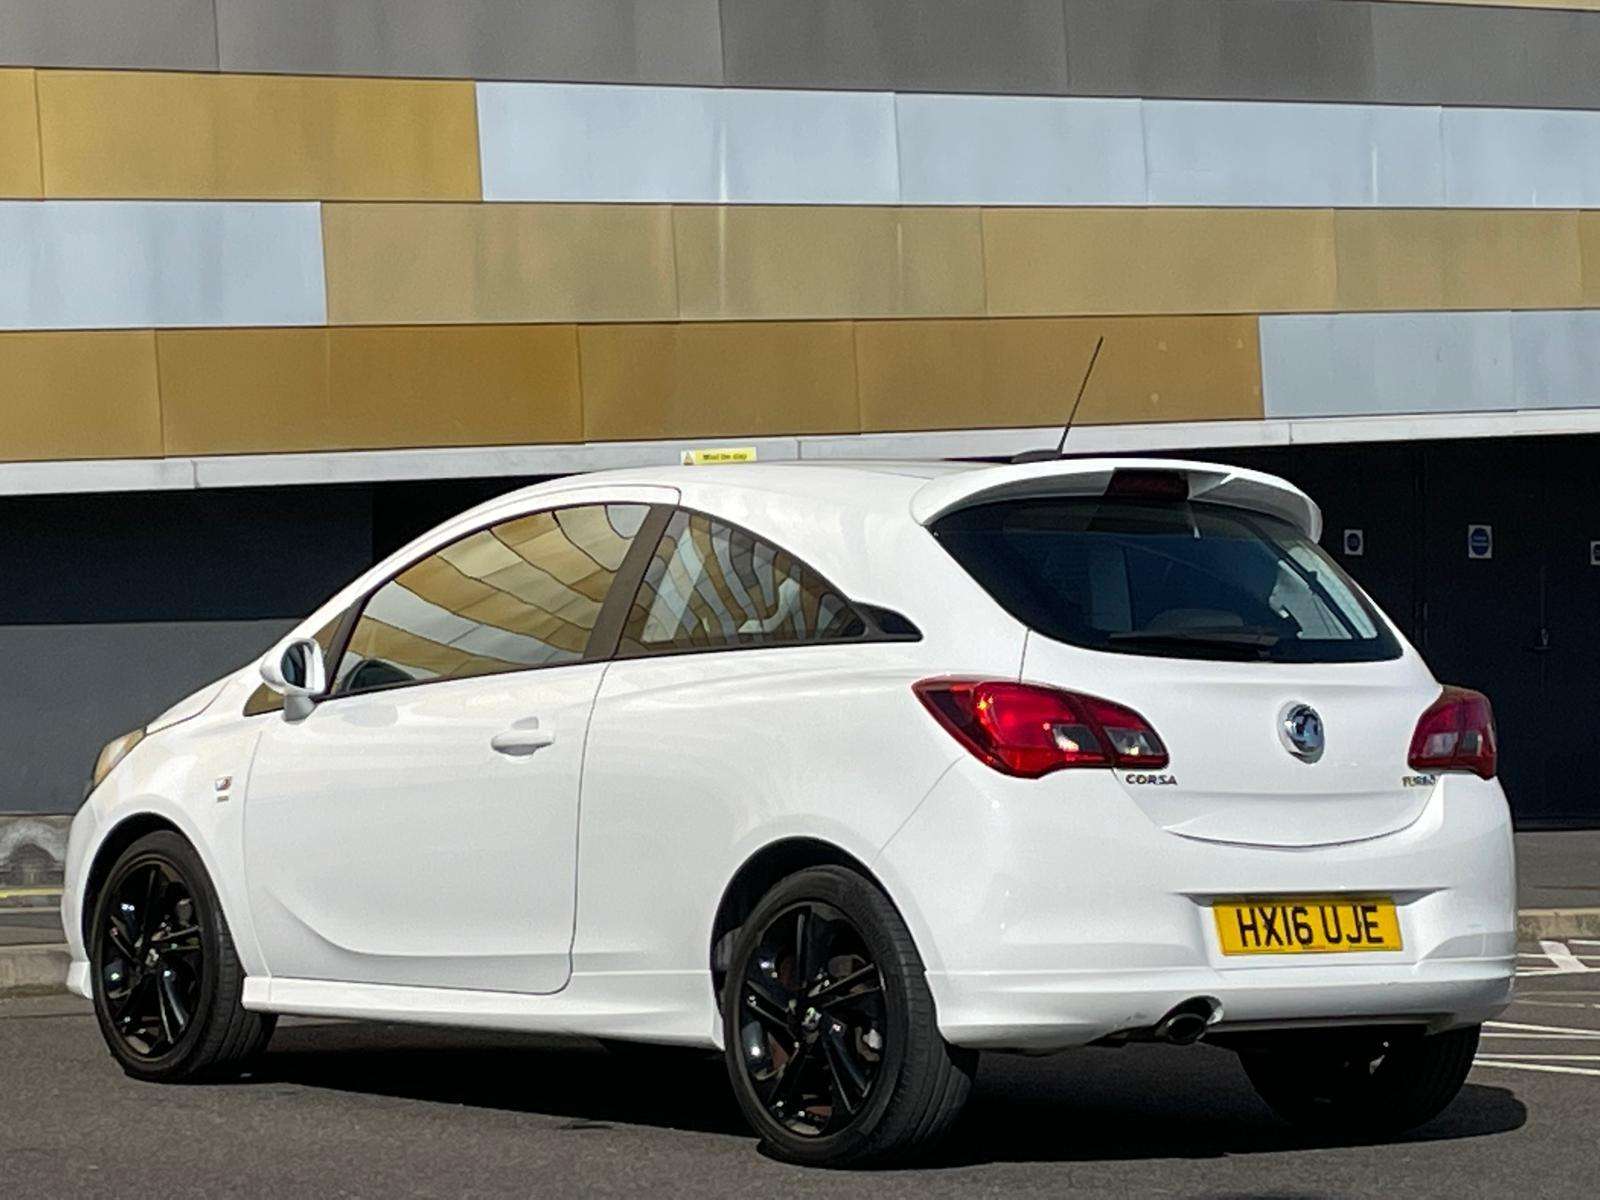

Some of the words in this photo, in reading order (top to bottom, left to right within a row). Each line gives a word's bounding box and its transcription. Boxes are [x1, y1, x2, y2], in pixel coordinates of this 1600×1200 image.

[1125, 773, 1178, 786] CORSA
[1236, 905, 1314, 947] HX16
[1319, 904, 1384, 944] UJE
